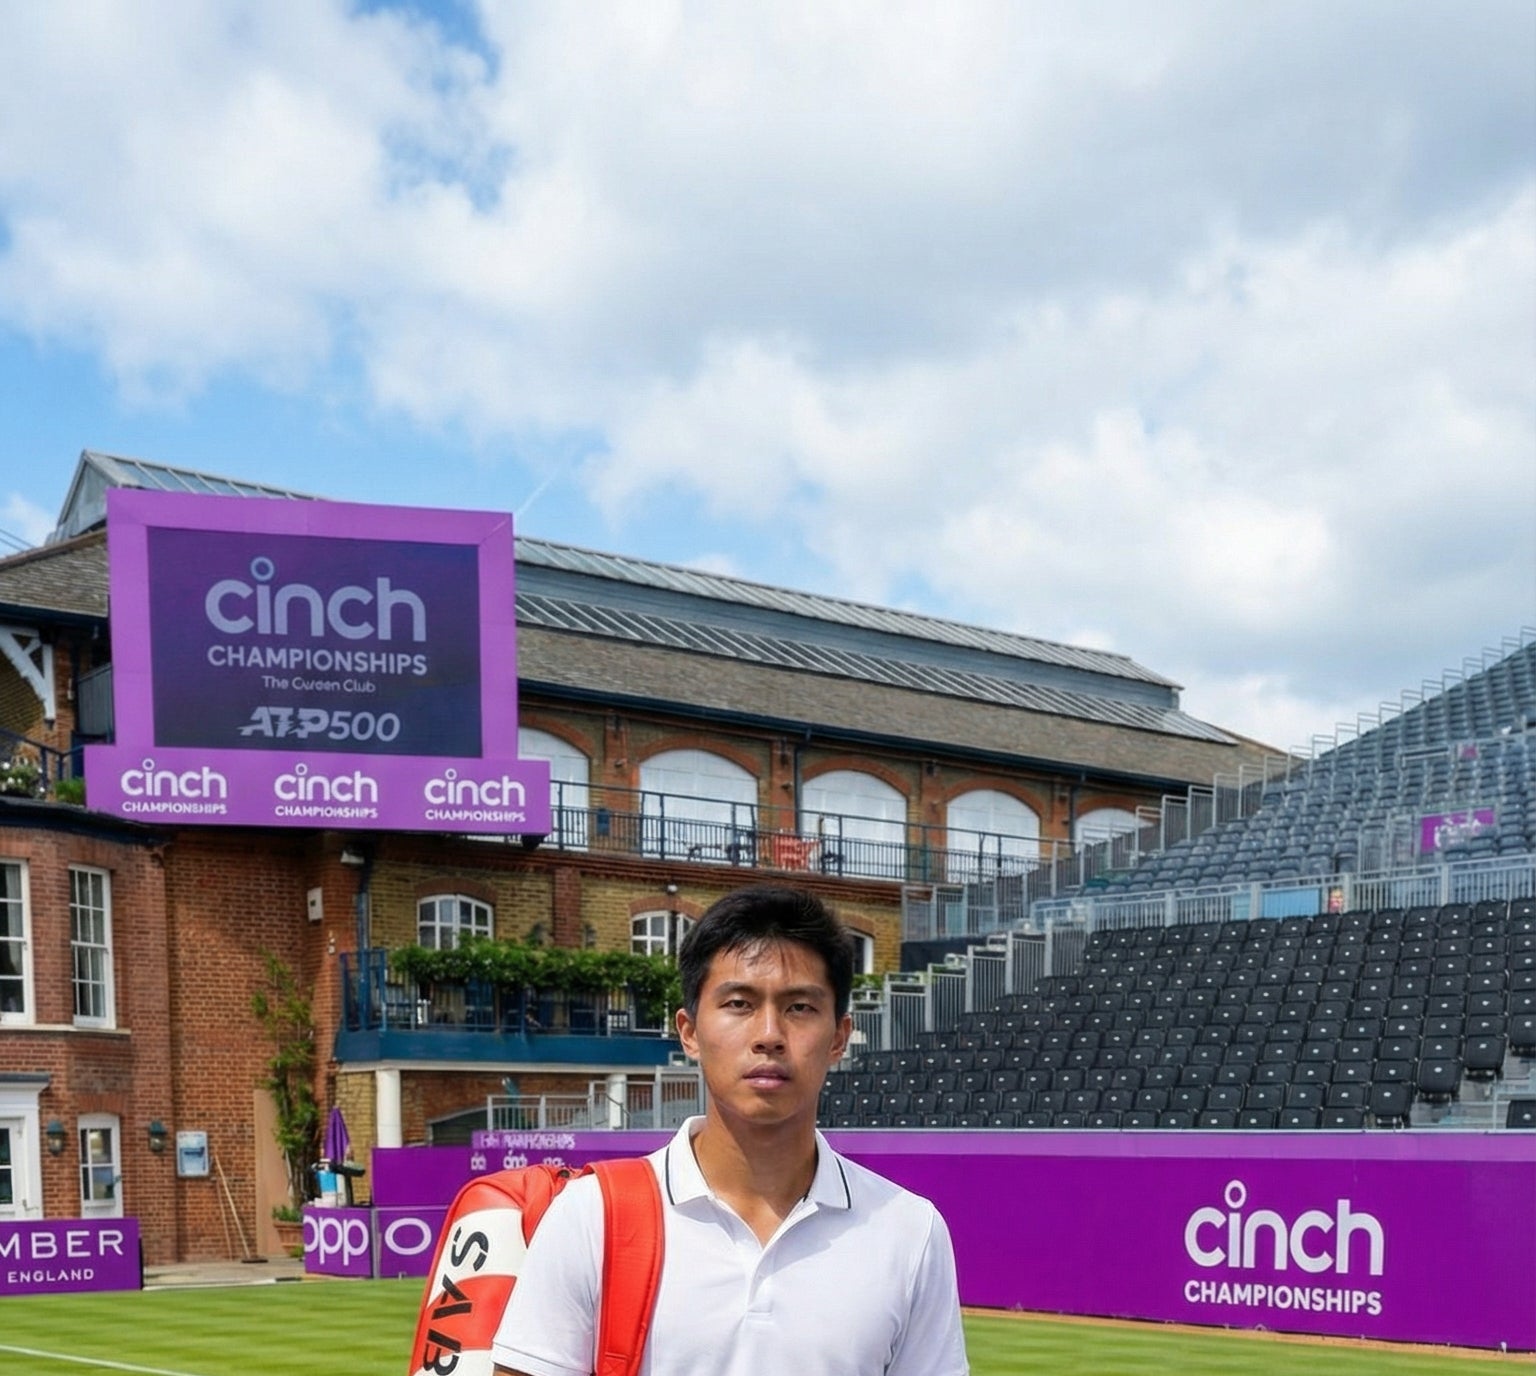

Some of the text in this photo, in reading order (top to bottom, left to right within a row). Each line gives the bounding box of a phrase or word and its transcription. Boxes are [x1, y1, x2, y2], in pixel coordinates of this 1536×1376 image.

[205, 557, 427, 642] cinch
[207, 645, 428, 676] CHAMPIONSHIPS
[261, 675, 289, 689] The
[121, 758, 227, 798] cinch
[274, 763, 378, 803] cinch
[424, 768, 525, 807] cinch
[1184, 1179, 1385, 1276] cinch
[7, 1268, 95, 1284] ENGLAND
[1184, 1280, 1382, 1316] CHAMPIONSHIPS
